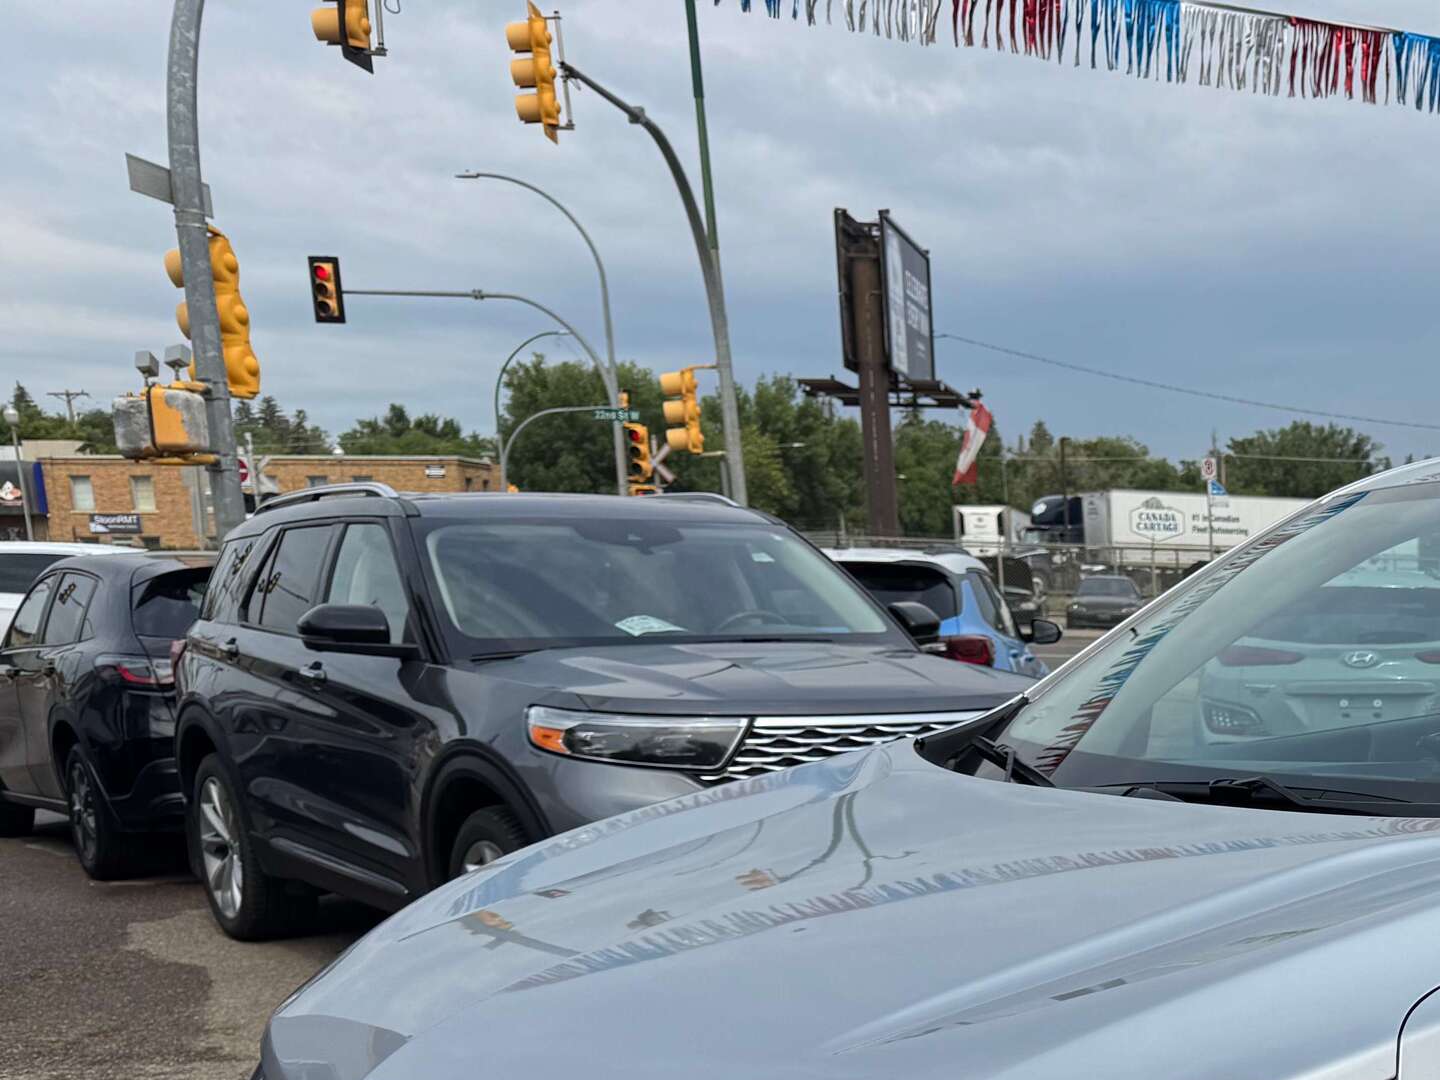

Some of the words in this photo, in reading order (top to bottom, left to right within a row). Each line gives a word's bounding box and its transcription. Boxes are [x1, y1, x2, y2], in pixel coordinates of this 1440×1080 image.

[1137, 512, 1177, 522] CANADA
[1211, 515, 1240, 523] Canadian
[1135, 522, 1178, 532] CARTAGE
